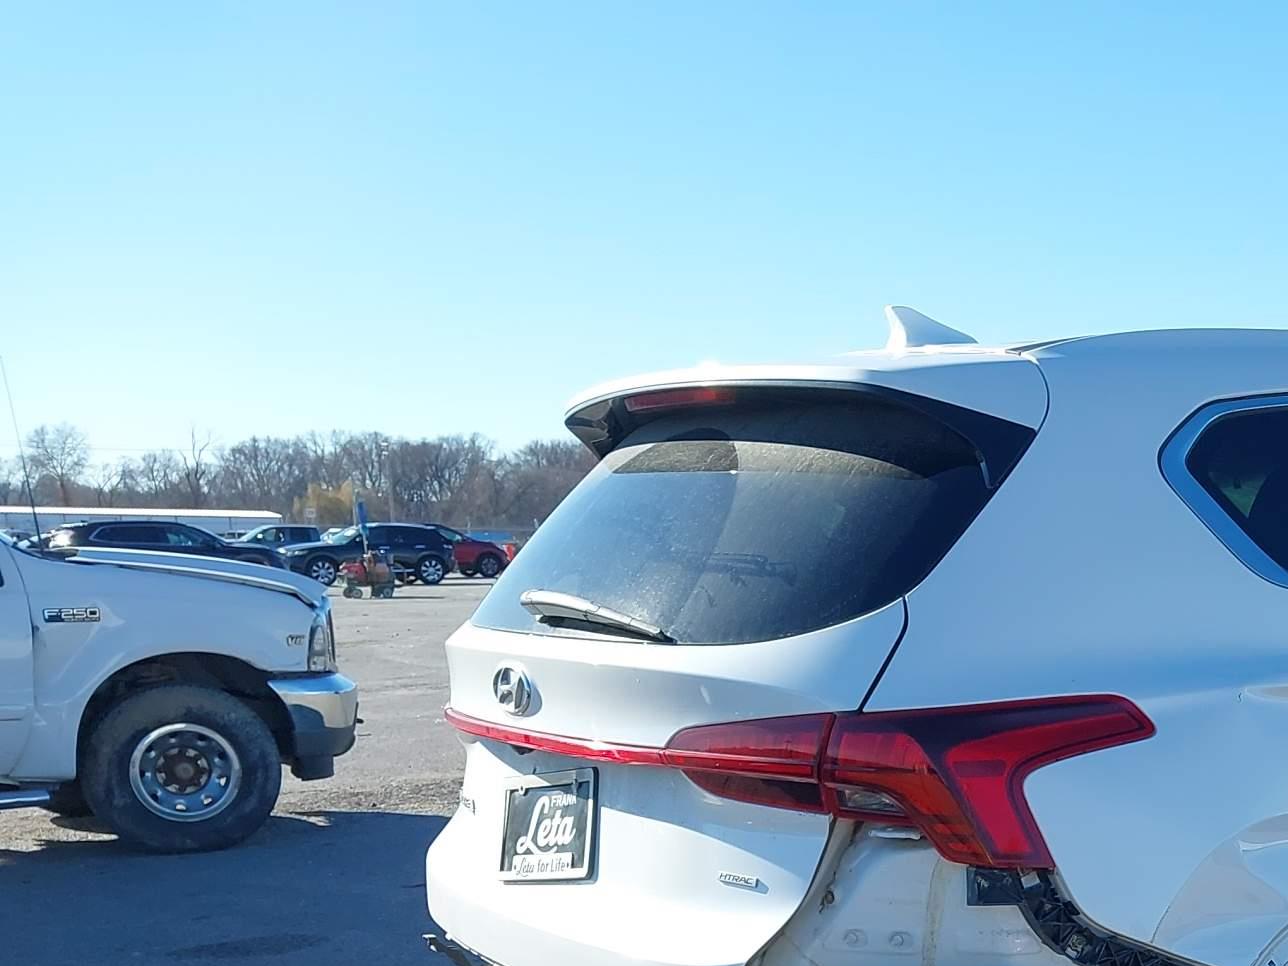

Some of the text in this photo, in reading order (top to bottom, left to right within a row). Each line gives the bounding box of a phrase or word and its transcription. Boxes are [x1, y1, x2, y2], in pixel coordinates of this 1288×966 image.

[516, 795, 576, 855] Leta
[537, 858, 549, 873] for
[550, 857, 566, 873] Life
[719, 872, 755, 886] HTRAC
